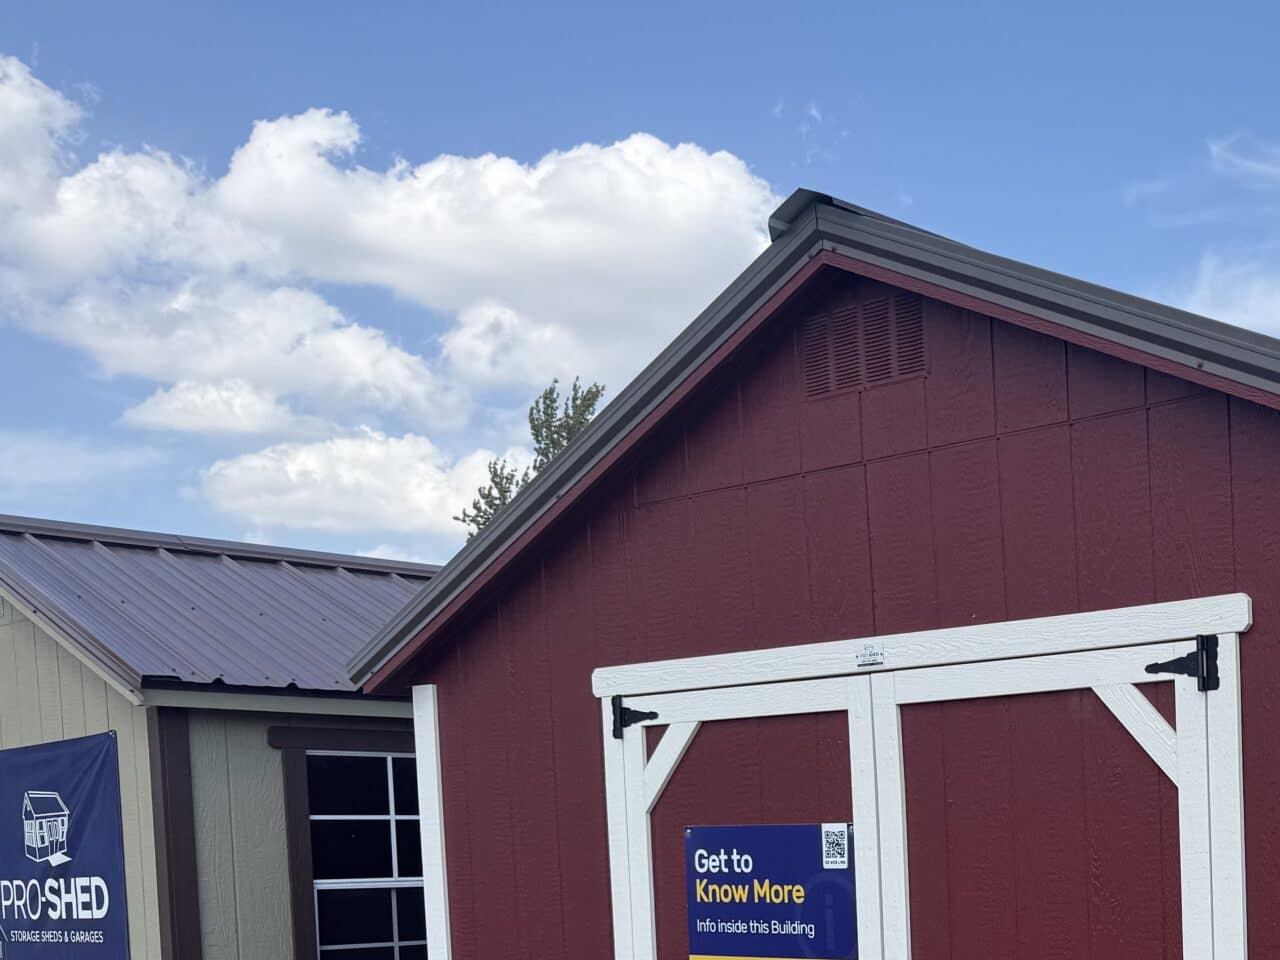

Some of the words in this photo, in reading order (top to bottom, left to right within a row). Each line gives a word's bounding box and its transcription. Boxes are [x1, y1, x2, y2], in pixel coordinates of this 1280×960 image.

[694, 848, 729, 873] Get
[731, 848, 753, 873] to
[695, 878, 749, 903] Know
[753, 878, 805, 904] More
[10, 930, 40, 942] STORAGE
[41, 930, 63, 942] SHEDS
[64, 931, 69, 943] &
[70, 930, 104, 943] GARAGES
[696, 918, 717, 933] Info
[718, 919, 748, 934] inside
[749, 919, 769, 934] this
[771, 920, 815, 939] Building
